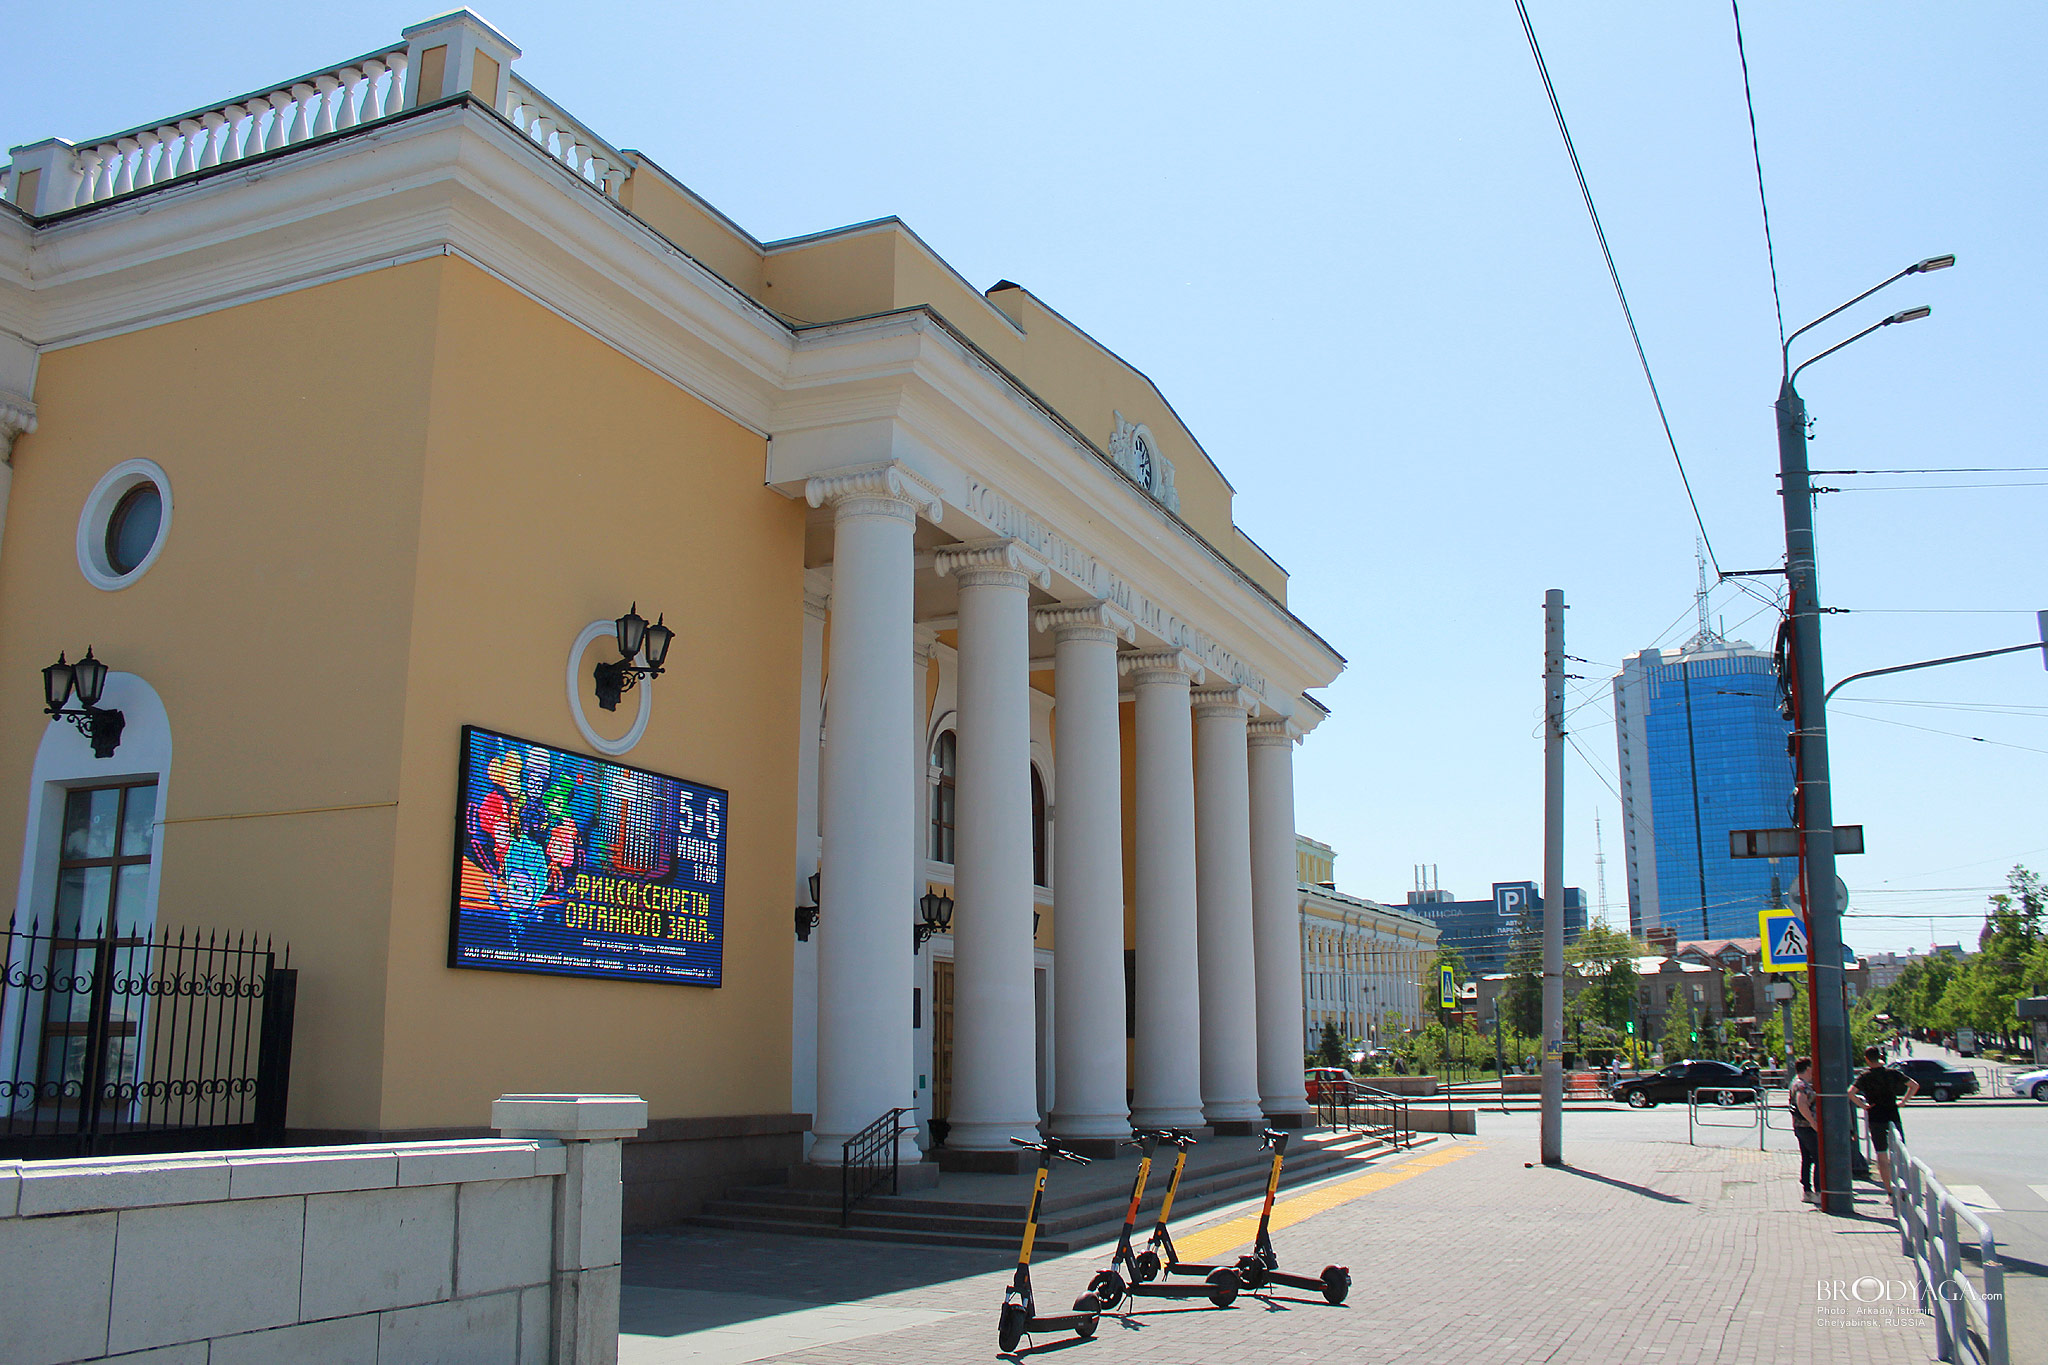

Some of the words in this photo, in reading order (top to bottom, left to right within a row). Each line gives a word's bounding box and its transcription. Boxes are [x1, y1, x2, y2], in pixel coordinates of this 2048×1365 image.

[679, 791, 720, 839] 5-6
[677, 835, 719, 865] ИЮНЯ
[693, 862, 718, 884] 11:00
[565, 901, 662, 938] ОРГАННОГО
